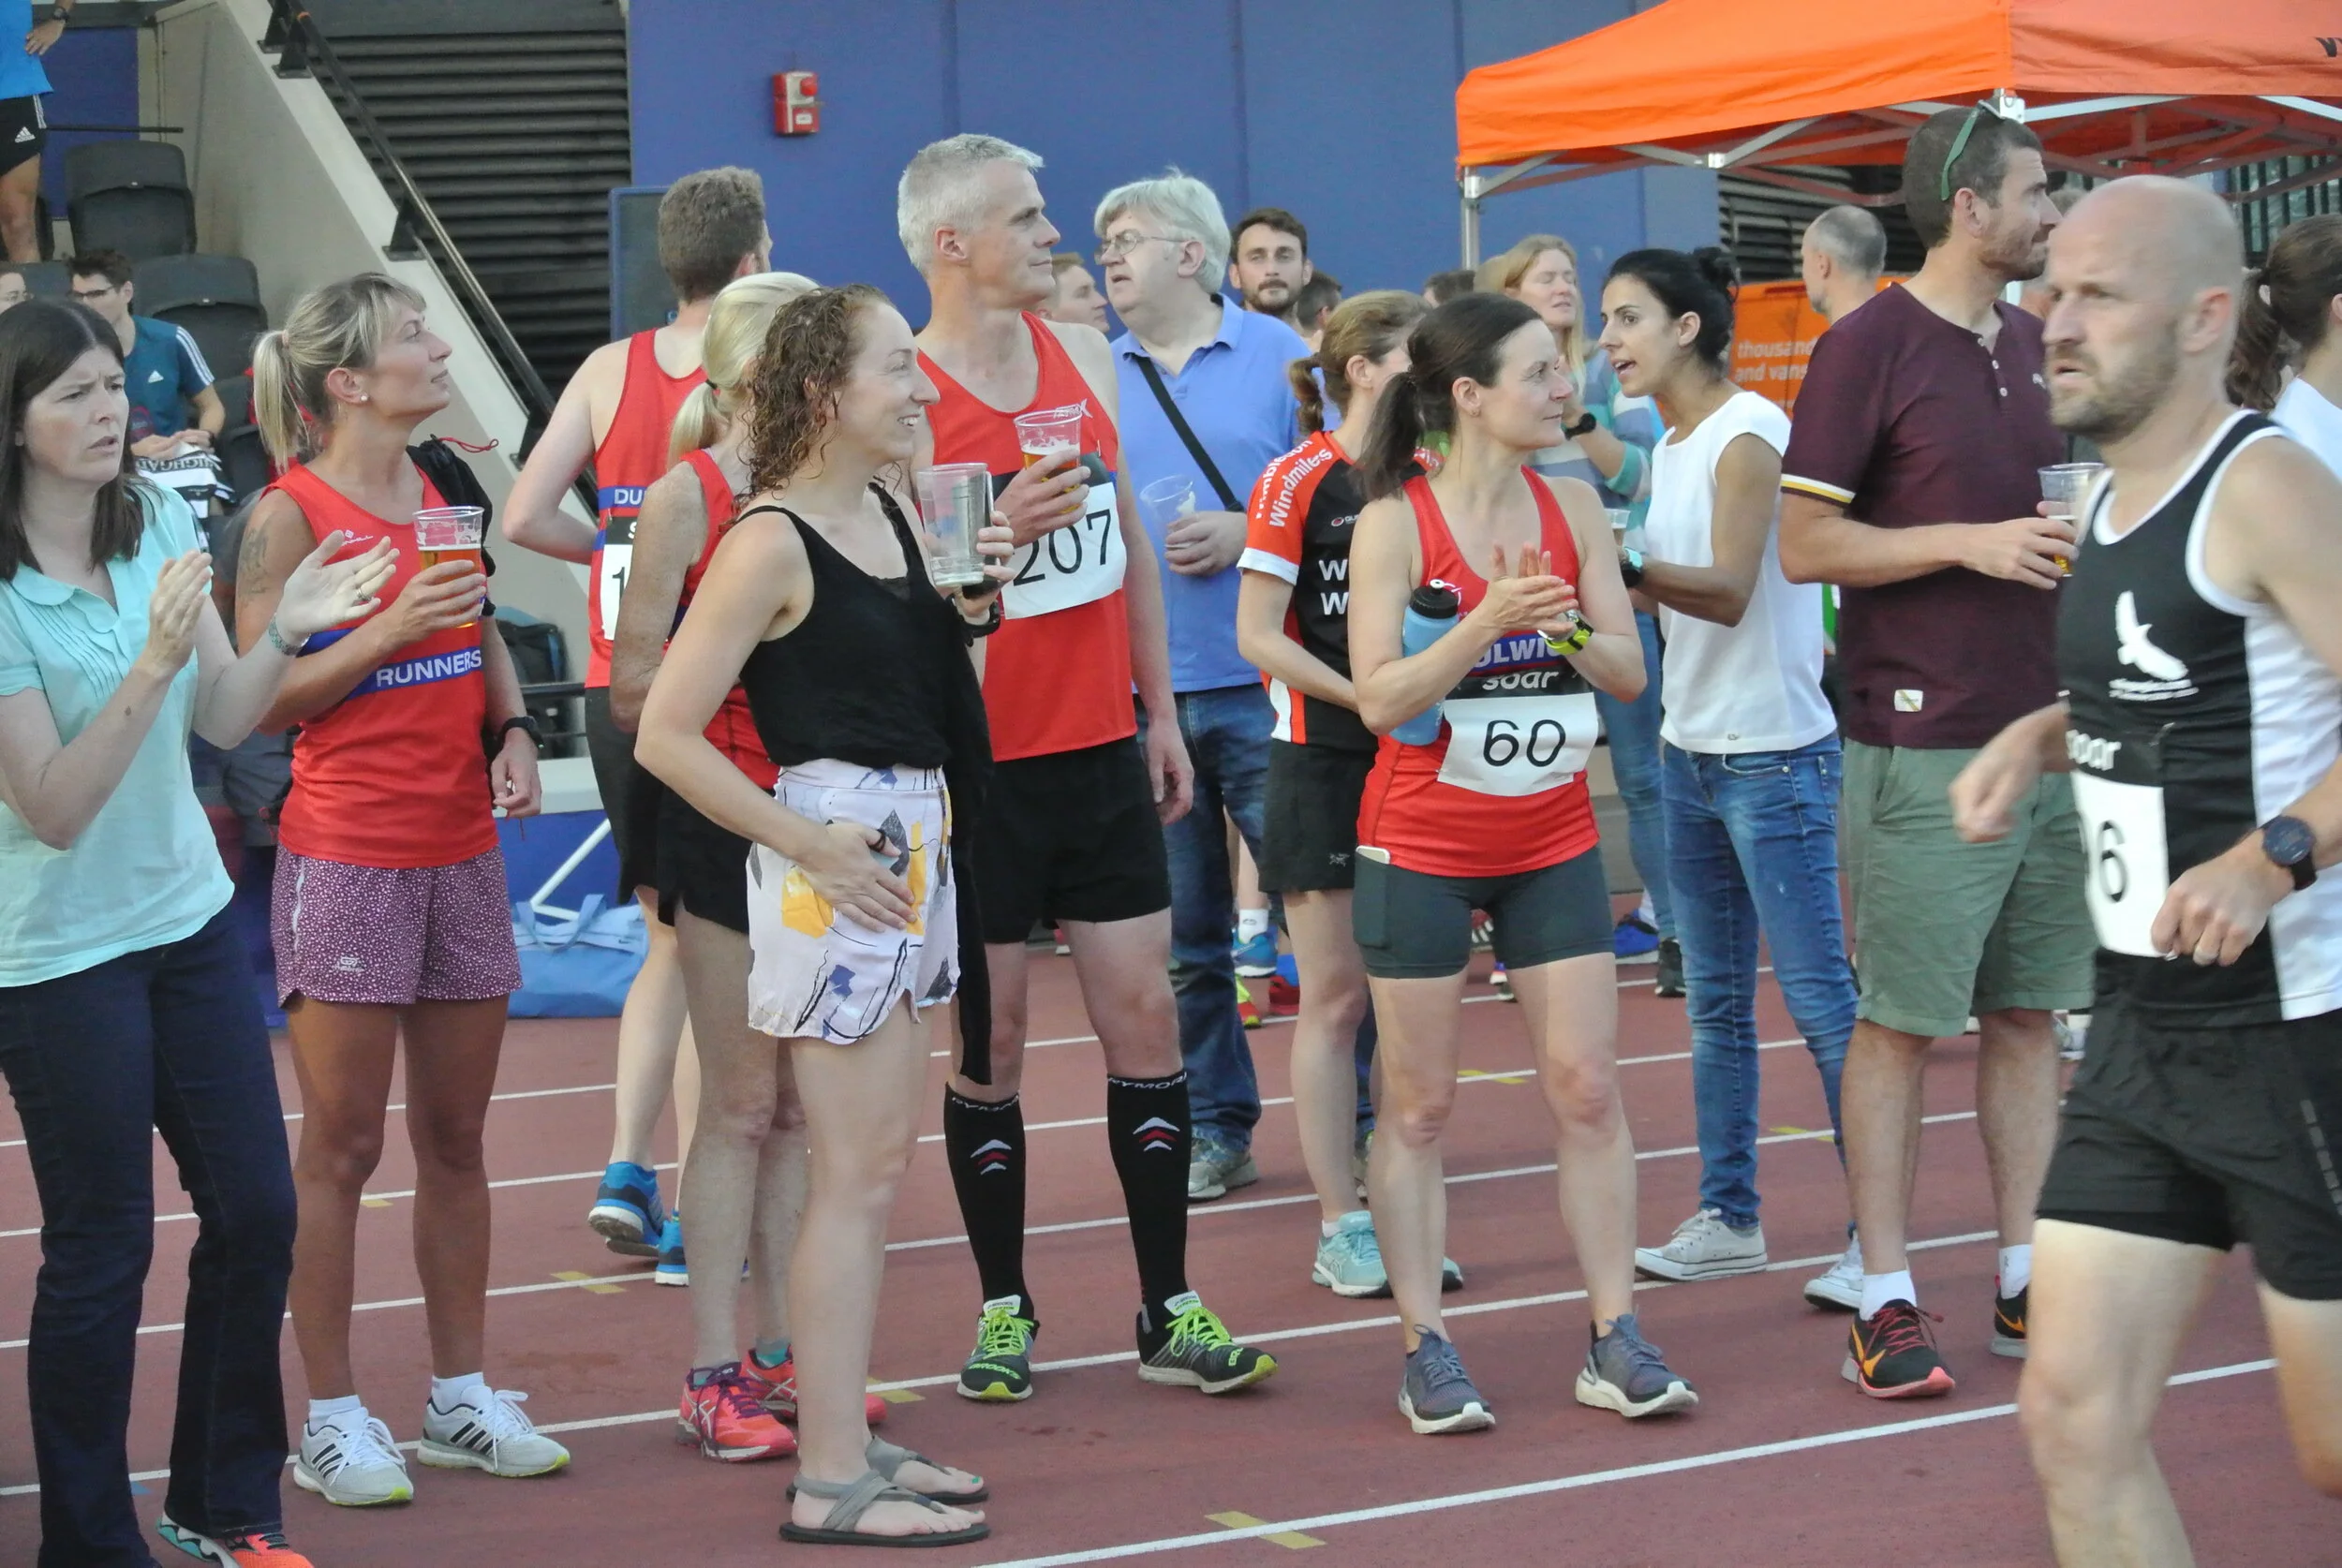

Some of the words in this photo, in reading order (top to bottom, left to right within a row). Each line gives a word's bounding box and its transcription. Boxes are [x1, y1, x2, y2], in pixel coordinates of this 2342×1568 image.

[1735, 362, 1766, 383] and
[614, 488, 646, 506] DU
[1013, 509, 1112, 586] 207
[376, 649, 482, 688] RUNNERS
[1482, 671, 1559, 690] soar
[1483, 719, 1566, 767] 60
